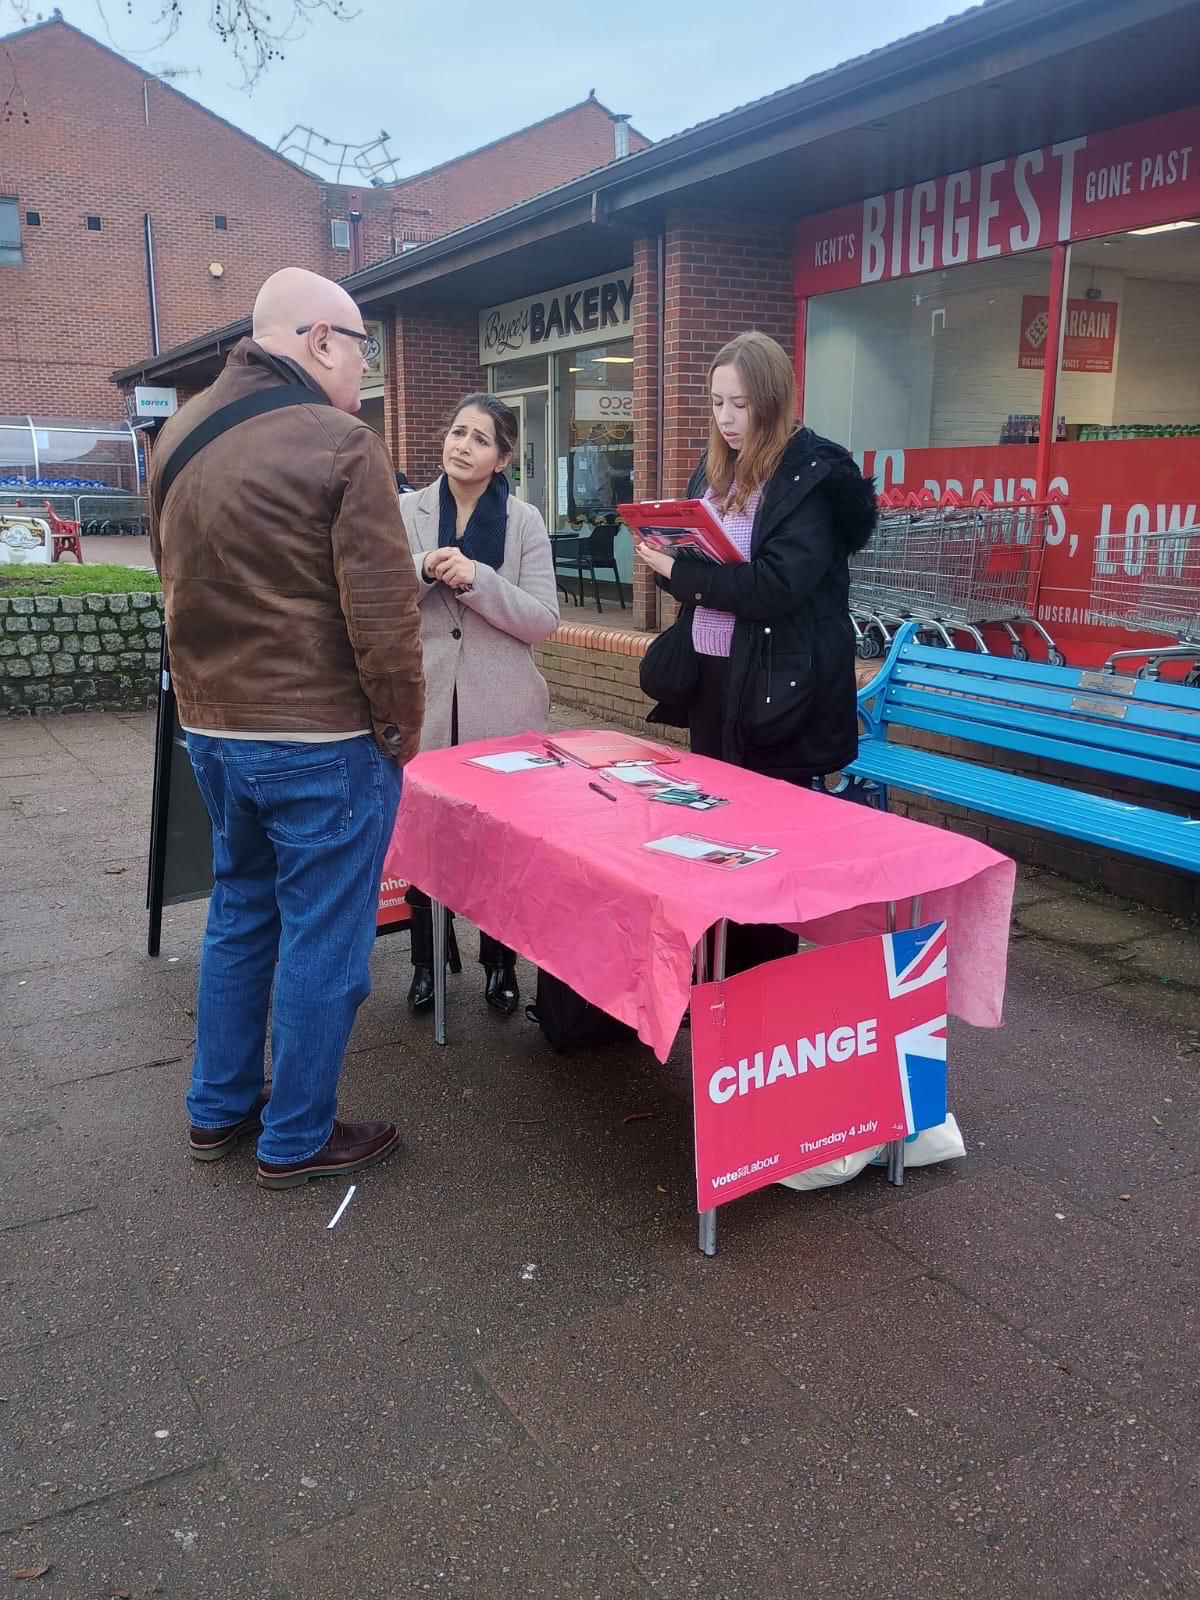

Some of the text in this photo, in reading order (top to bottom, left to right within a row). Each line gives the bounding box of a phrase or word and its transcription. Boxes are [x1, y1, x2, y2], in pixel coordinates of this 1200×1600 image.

[815, 136, 1192, 284] KENT'S BIGGEST GONE PAST
[530, 278, 634, 345] BAKERY
[1066, 310, 1110, 339] RGAIN
[708, 1018, 878, 1104] CHANGE
[800, 1130, 847, 1154] Thursday
[849, 1126, 856, 1136] 4
[857, 1120, 878, 1135] July
[712, 1154, 781, 1189] Vote Labour
